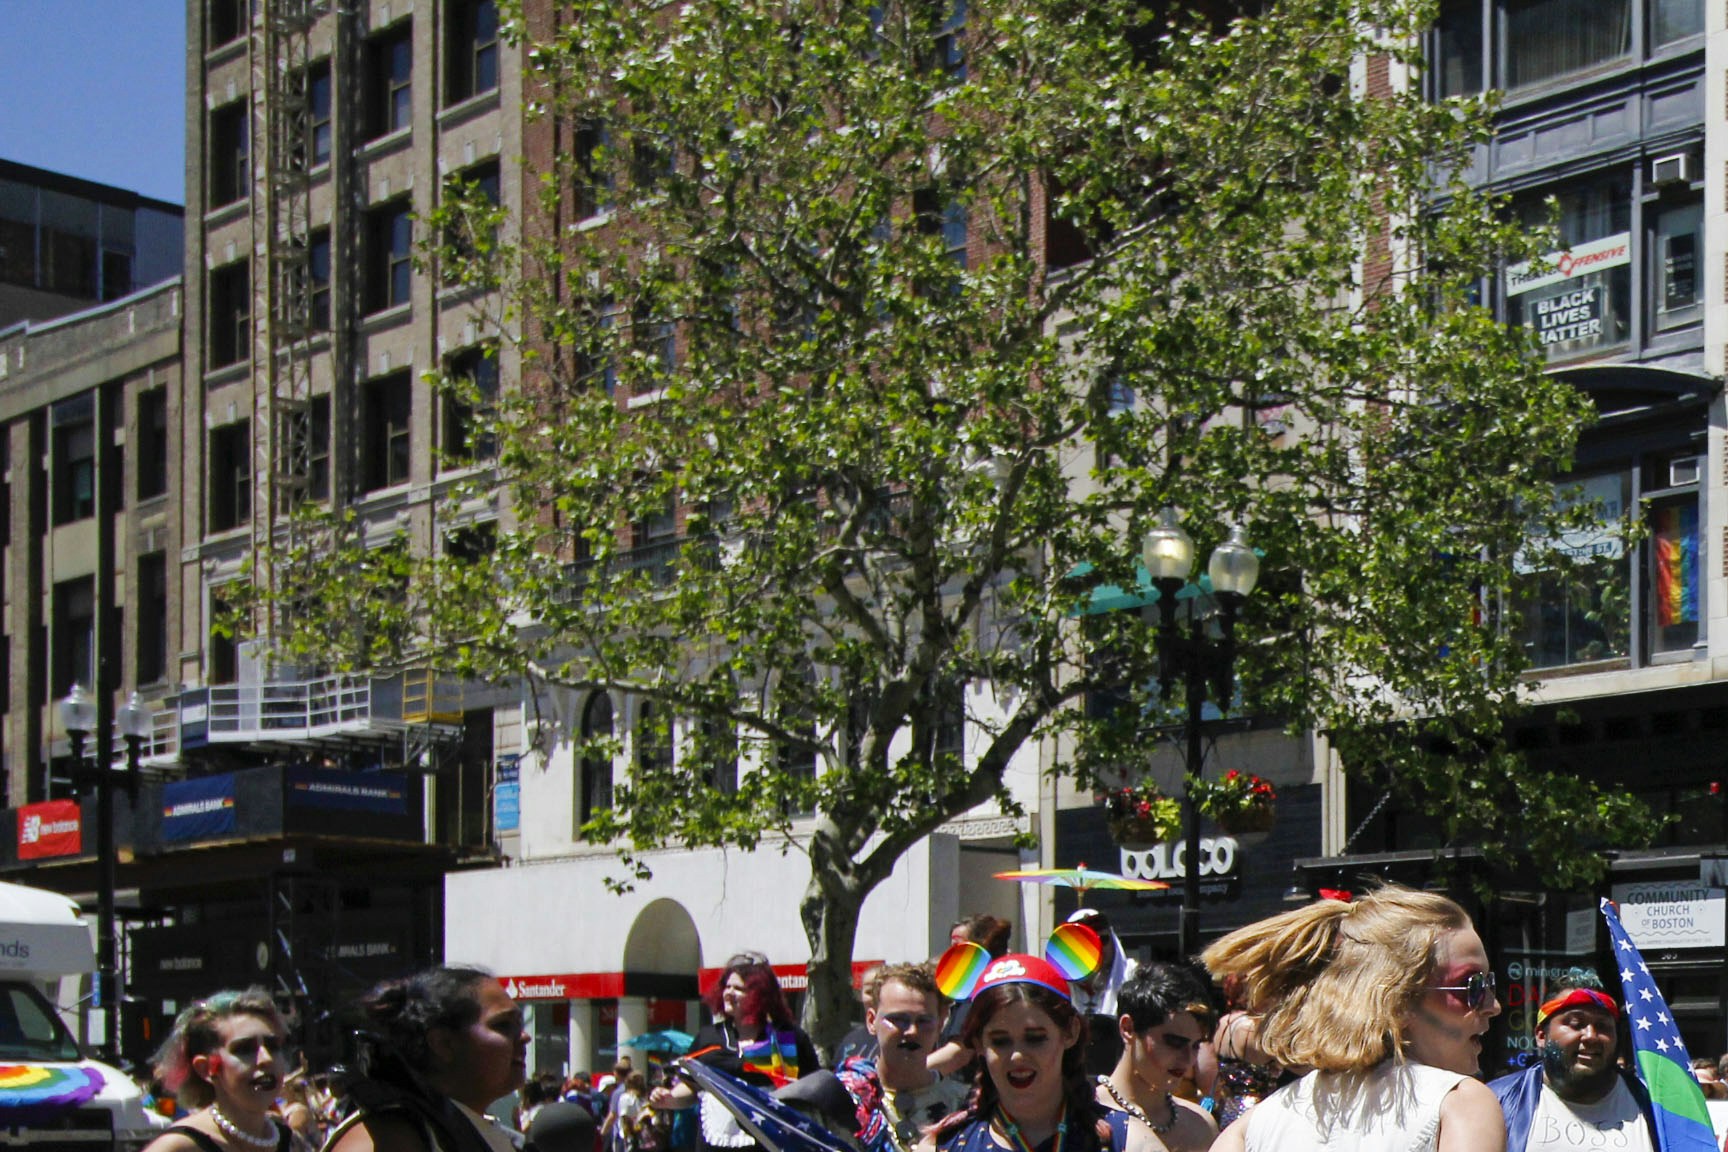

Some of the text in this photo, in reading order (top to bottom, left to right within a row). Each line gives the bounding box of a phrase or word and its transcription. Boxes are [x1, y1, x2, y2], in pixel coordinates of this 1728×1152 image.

[1537, 289, 1594, 314] BLACK
[1541, 305, 1591, 329] LIVES
[308, 783, 389, 799] ADMIRALS BANK
[1627, 889, 1710, 905] COMMUNITY
[1646, 904, 1690, 917] CHURCH
[1652, 917, 1694, 929] BOSTON
[518, 979, 565, 998] Santander
